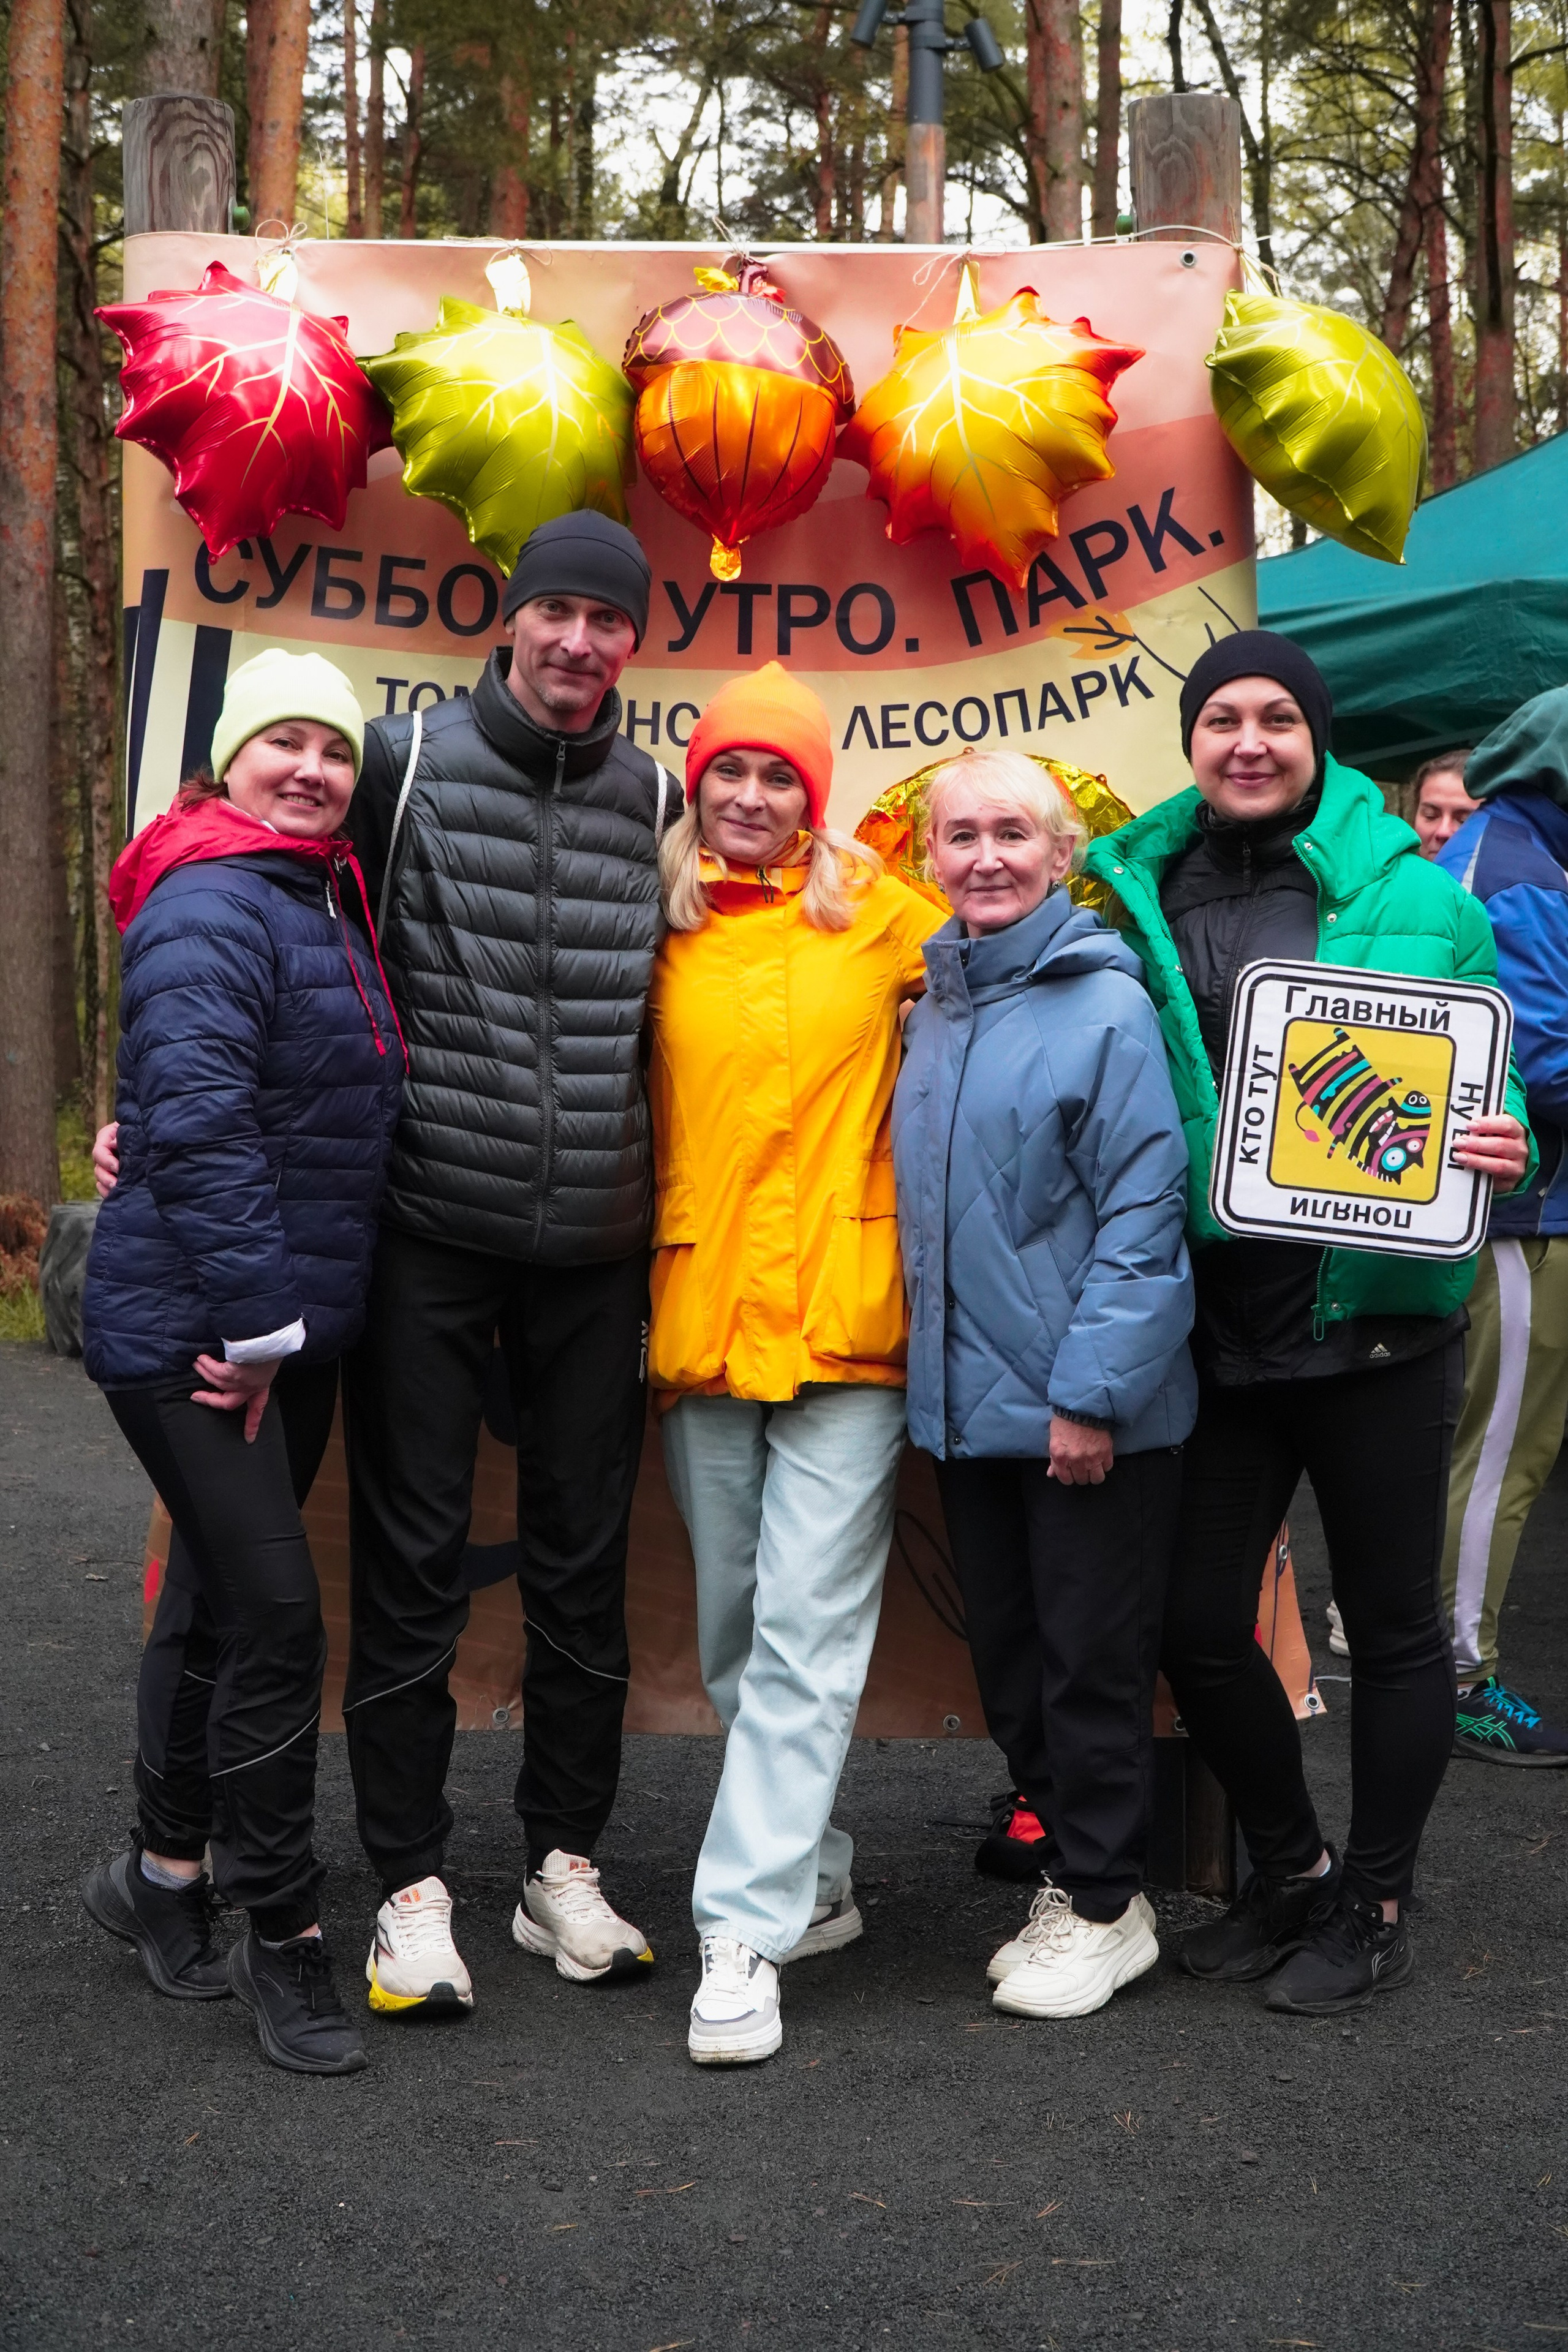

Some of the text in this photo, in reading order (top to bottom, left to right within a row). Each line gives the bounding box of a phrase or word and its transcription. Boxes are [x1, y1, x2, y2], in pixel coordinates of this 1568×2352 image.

[194, 486, 1225, 656] СУББО УТРО. ПАРК.
[841, 655, 1155, 750] ЛЕСОПАРК
[1284, 984, 1451, 1031] Главный
[1248, 1044, 1278, 1098] тут
[1450, 1082, 1484, 1121] Ну
[1289, 1196, 1412, 1229] поняли
[1084, 1929, 1094, 1940] FILA
